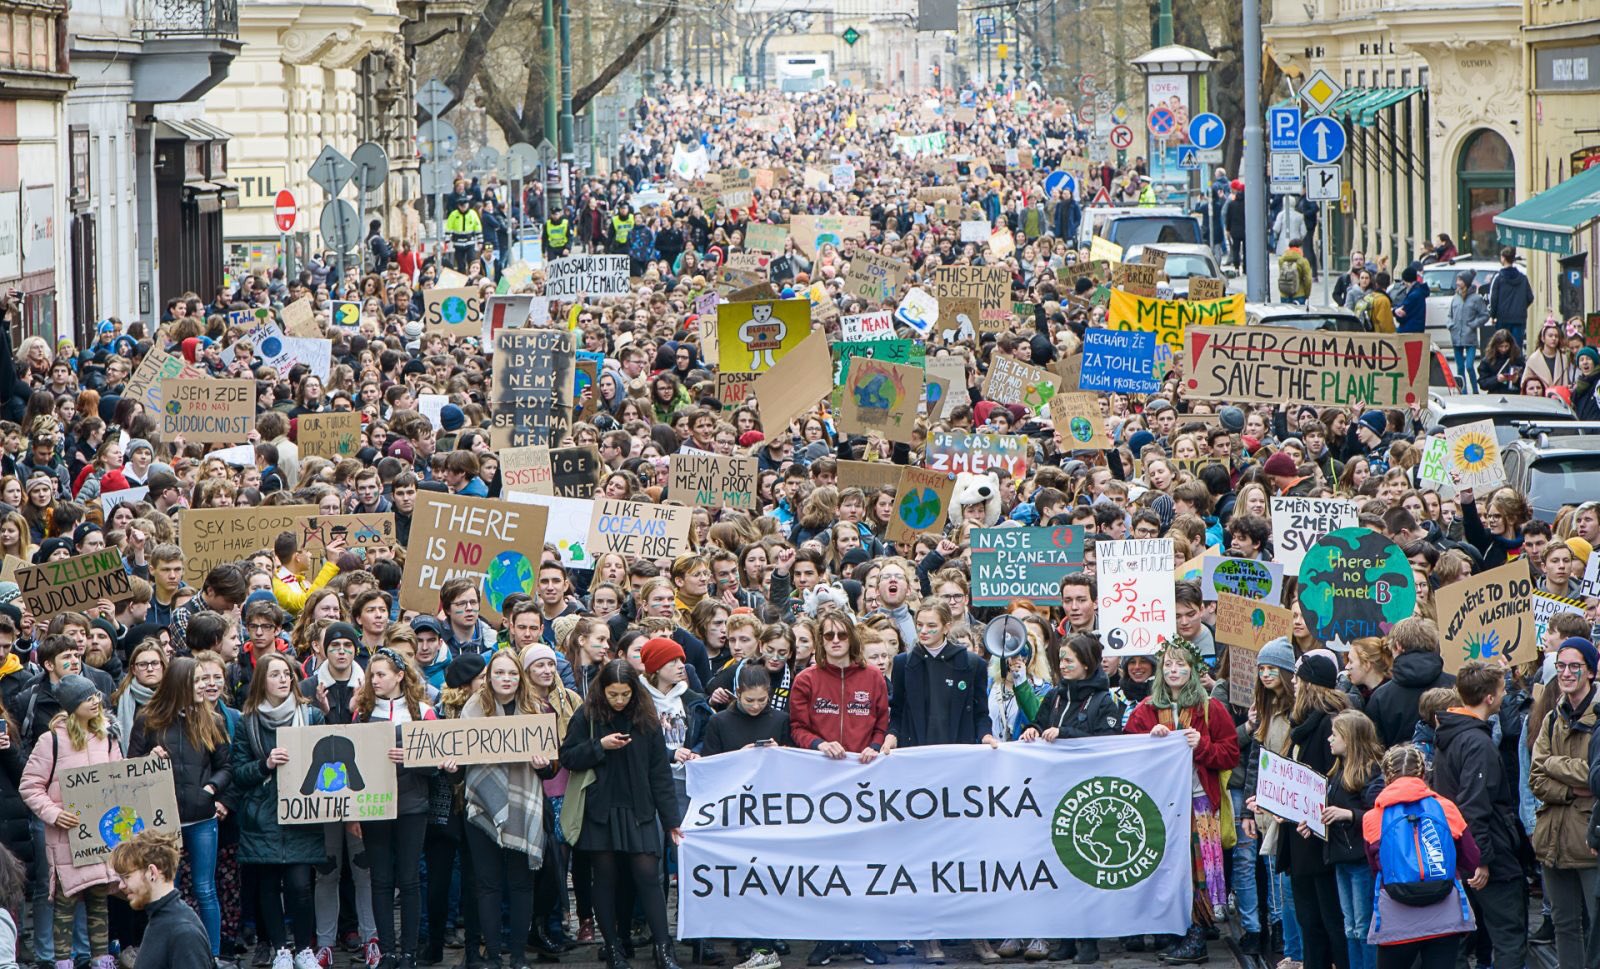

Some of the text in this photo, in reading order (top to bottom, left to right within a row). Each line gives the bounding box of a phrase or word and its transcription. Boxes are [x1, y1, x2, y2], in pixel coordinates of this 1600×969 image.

[1460, 57, 1493, 68] OLYMPIA
[598, 257, 607, 272] SI
[730, 255, 757, 266] MAKE
[936, 267, 1011, 284] THIS PLANET
[937, 282, 1006, 298] IS GETTING
[861, 316, 890, 333] MEAN
[500, 334, 572, 353] NEMŮŽU
[1086, 331, 1129, 348] NECHÁPU
[1132, 333, 1146, 349] ŽE
[515, 350, 551, 367] BÝT
[887, 344, 906, 358] SE
[1212, 331, 1278, 361] KEEP
[1280, 335, 1339, 367] CALM
[1343, 337, 1400, 371] AND
[995, 355, 1041, 381] THE TEA IS
[1085, 352, 1103, 367] ZA
[1103, 354, 1152, 374] TOHLE
[509, 369, 557, 387] NĚMÝ
[1081, 370, 1162, 393] MUSÍM PROTESTOVAT
[1210, 364, 1405, 405] SAVE THE PLANET
[172, 386, 248, 401] JSEM ZDE
[515, 391, 558, 410] KDYŽ
[189, 402, 207, 411] PRO
[163, 415, 250, 435] BUDOUCNOST
[303, 416, 352, 431] OUR FUTURE
[495, 413, 569, 431] SE KLIMA
[329, 430, 339, 438] IN
[934, 433, 1018, 450] JE ČAS NA
[675, 457, 748, 476] KLIMA SE
[932, 450, 1019, 474] ZMĚNY
[721, 473, 753, 493] PROČ
[695, 490, 717, 505] NE
[602, 500, 676, 521] LIKE THE
[1274, 497, 1359, 518] ZMĚŇ SYSTÉM
[193, 516, 293, 538] SEX IS GOOD
[428, 501, 520, 542] THERE
[598, 516, 668, 537] OCEANS
[194, 538, 270, 553] BUT HAVE U
[606, 533, 679, 558] WE RISE
[979, 532, 1031, 549] NAŠE
[1099, 542, 1118, 557] WE
[425, 536, 483, 566] IS NO
[997, 549, 1068, 564] PLANETA
[1326, 549, 1386, 569] there is
[18, 549, 122, 593] ZA ZELENOU
[979, 563, 1027, 580] NAŠE
[1221, 566, 1266, 578] DENYING
[1231, 560, 1254, 568] STOP
[1241, 575, 1269, 584] EARTH
[1343, 571, 1361, 583] no
[979, 582, 1062, 597] BUDOUCNO
[1324, 580, 1392, 604] planet B
[1445, 578, 1531, 641] VEZMĚME TO DO
[1479, 596, 1531, 626] VLASTNÍCH
[1317, 615, 1377, 640] EARTH
[66, 770, 100, 789] SAVE
[126, 756, 173, 778] PLANET
[356, 792, 393, 804] GREEN
[694, 777, 1043, 827] STŘEDOŠKOLSKÁ
[280, 796, 350, 820] JOIN THE
[359, 804, 385, 817] SIDE
[1055, 780, 1143, 836] FRIDAYS FOR
[1096, 847, 1159, 885] FUTURE
[692, 856, 1059, 898] STÁVKA ZA KLIMA
